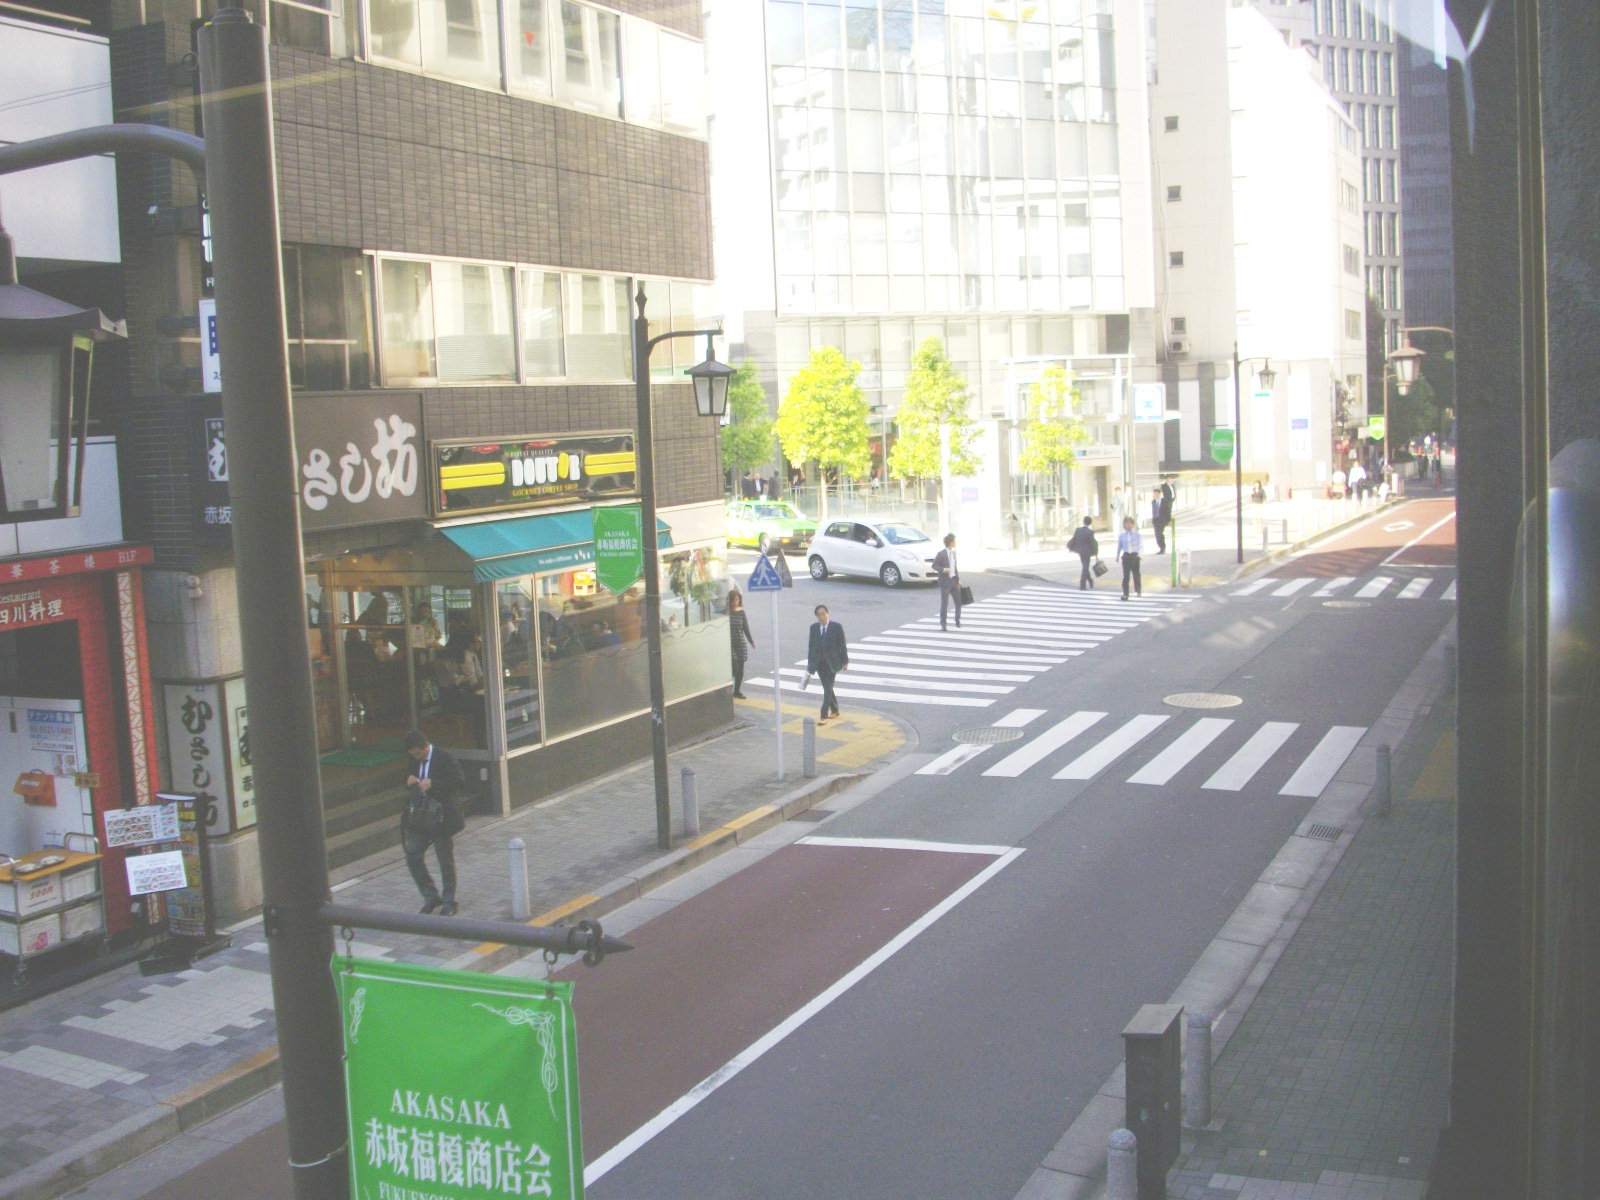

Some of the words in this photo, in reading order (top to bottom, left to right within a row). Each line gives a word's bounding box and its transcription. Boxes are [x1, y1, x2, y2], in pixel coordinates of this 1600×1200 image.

[531, 449, 554, 457] QUALITY
[511, 452, 581, 487] DOUTOR
[513, 487, 542, 496] GOURMET
[565, 483, 579, 491] SHOP
[204, 505, 232, 524] 赤坂
[119, 551, 137, 563] B1F
[390, 1088, 512, 1130] AKASAKA
[365, 1116, 552, 1199] 赤坂福榎商店会
